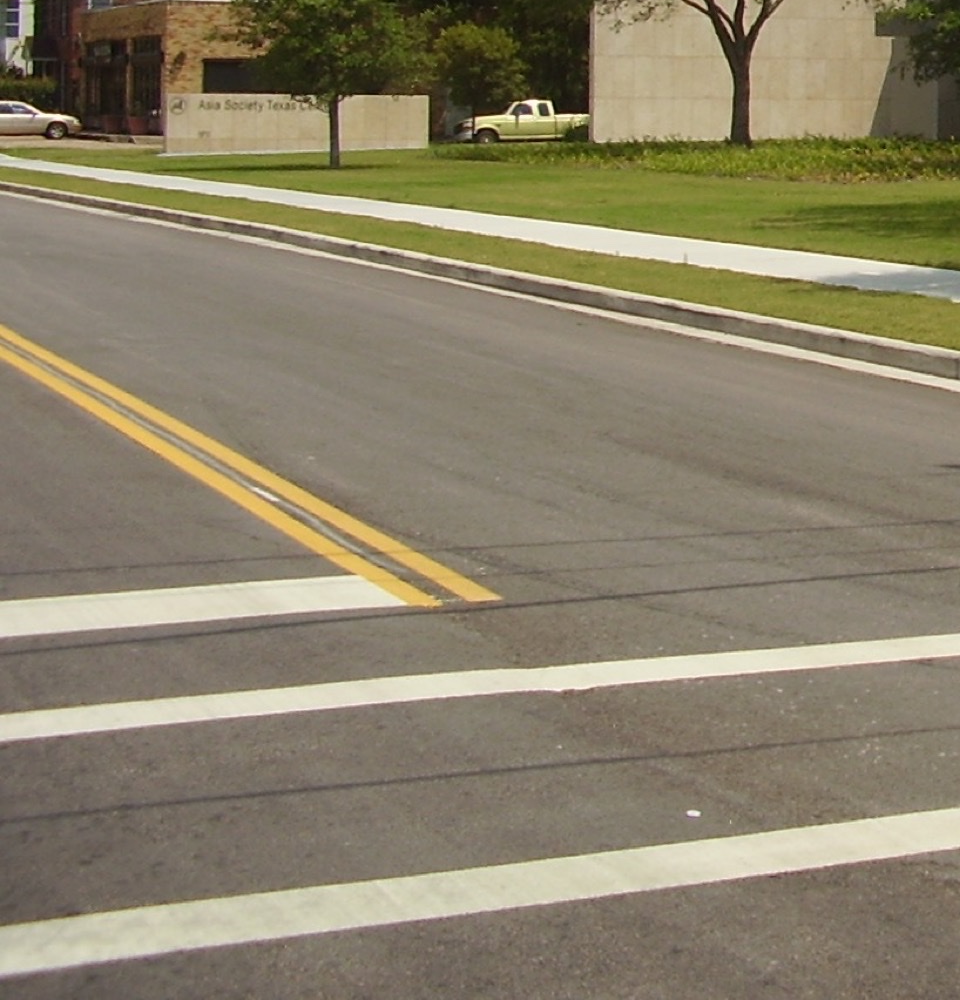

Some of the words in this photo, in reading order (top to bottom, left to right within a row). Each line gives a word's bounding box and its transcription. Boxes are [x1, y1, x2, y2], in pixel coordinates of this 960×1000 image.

[198, 99, 221, 111] Asia
[224, 99, 264, 113] Society
[267, 99, 297, 111] Texas
